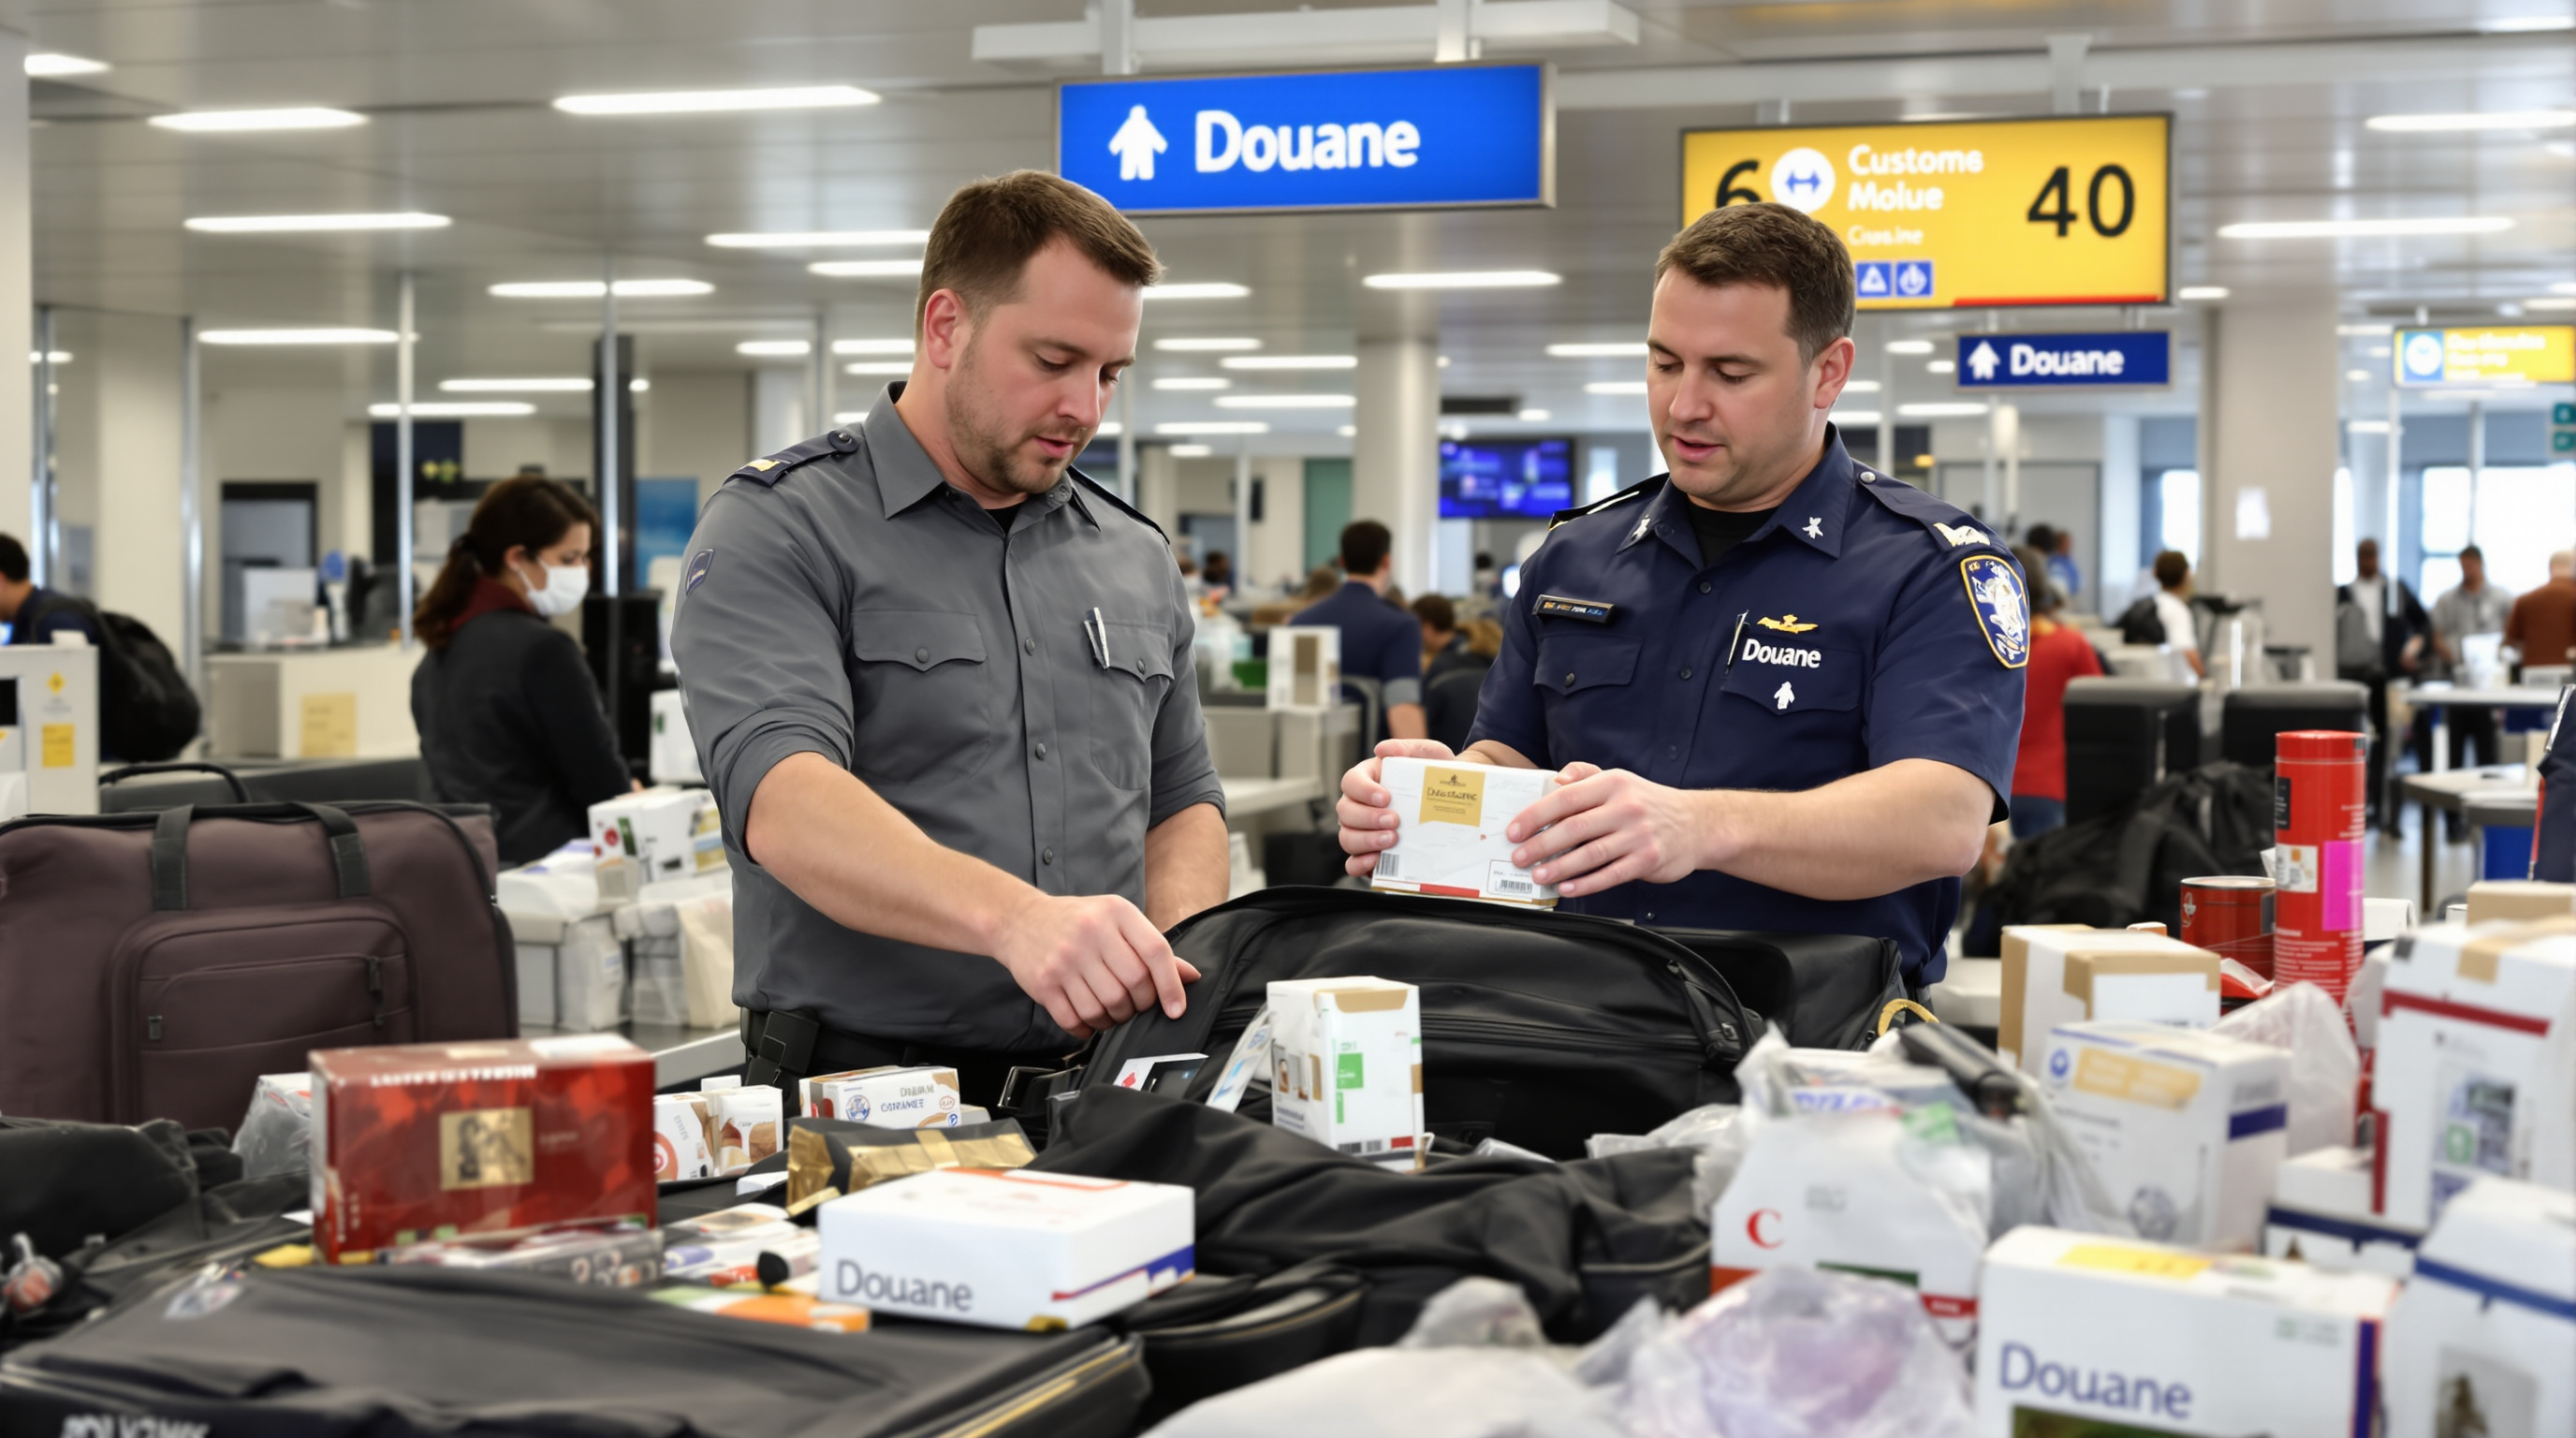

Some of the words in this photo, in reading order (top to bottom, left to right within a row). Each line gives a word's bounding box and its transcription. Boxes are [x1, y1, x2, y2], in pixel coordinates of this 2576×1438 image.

[1194, 110, 1421, 172] Douane
[2027, 164, 2135, 238] 40
[2010, 343, 2125, 376] Douane
[1742, 638, 1822, 668] Douane
[835, 1258, 973, 1313] Douane
[2000, 1343, 2191, 1419] Douane
